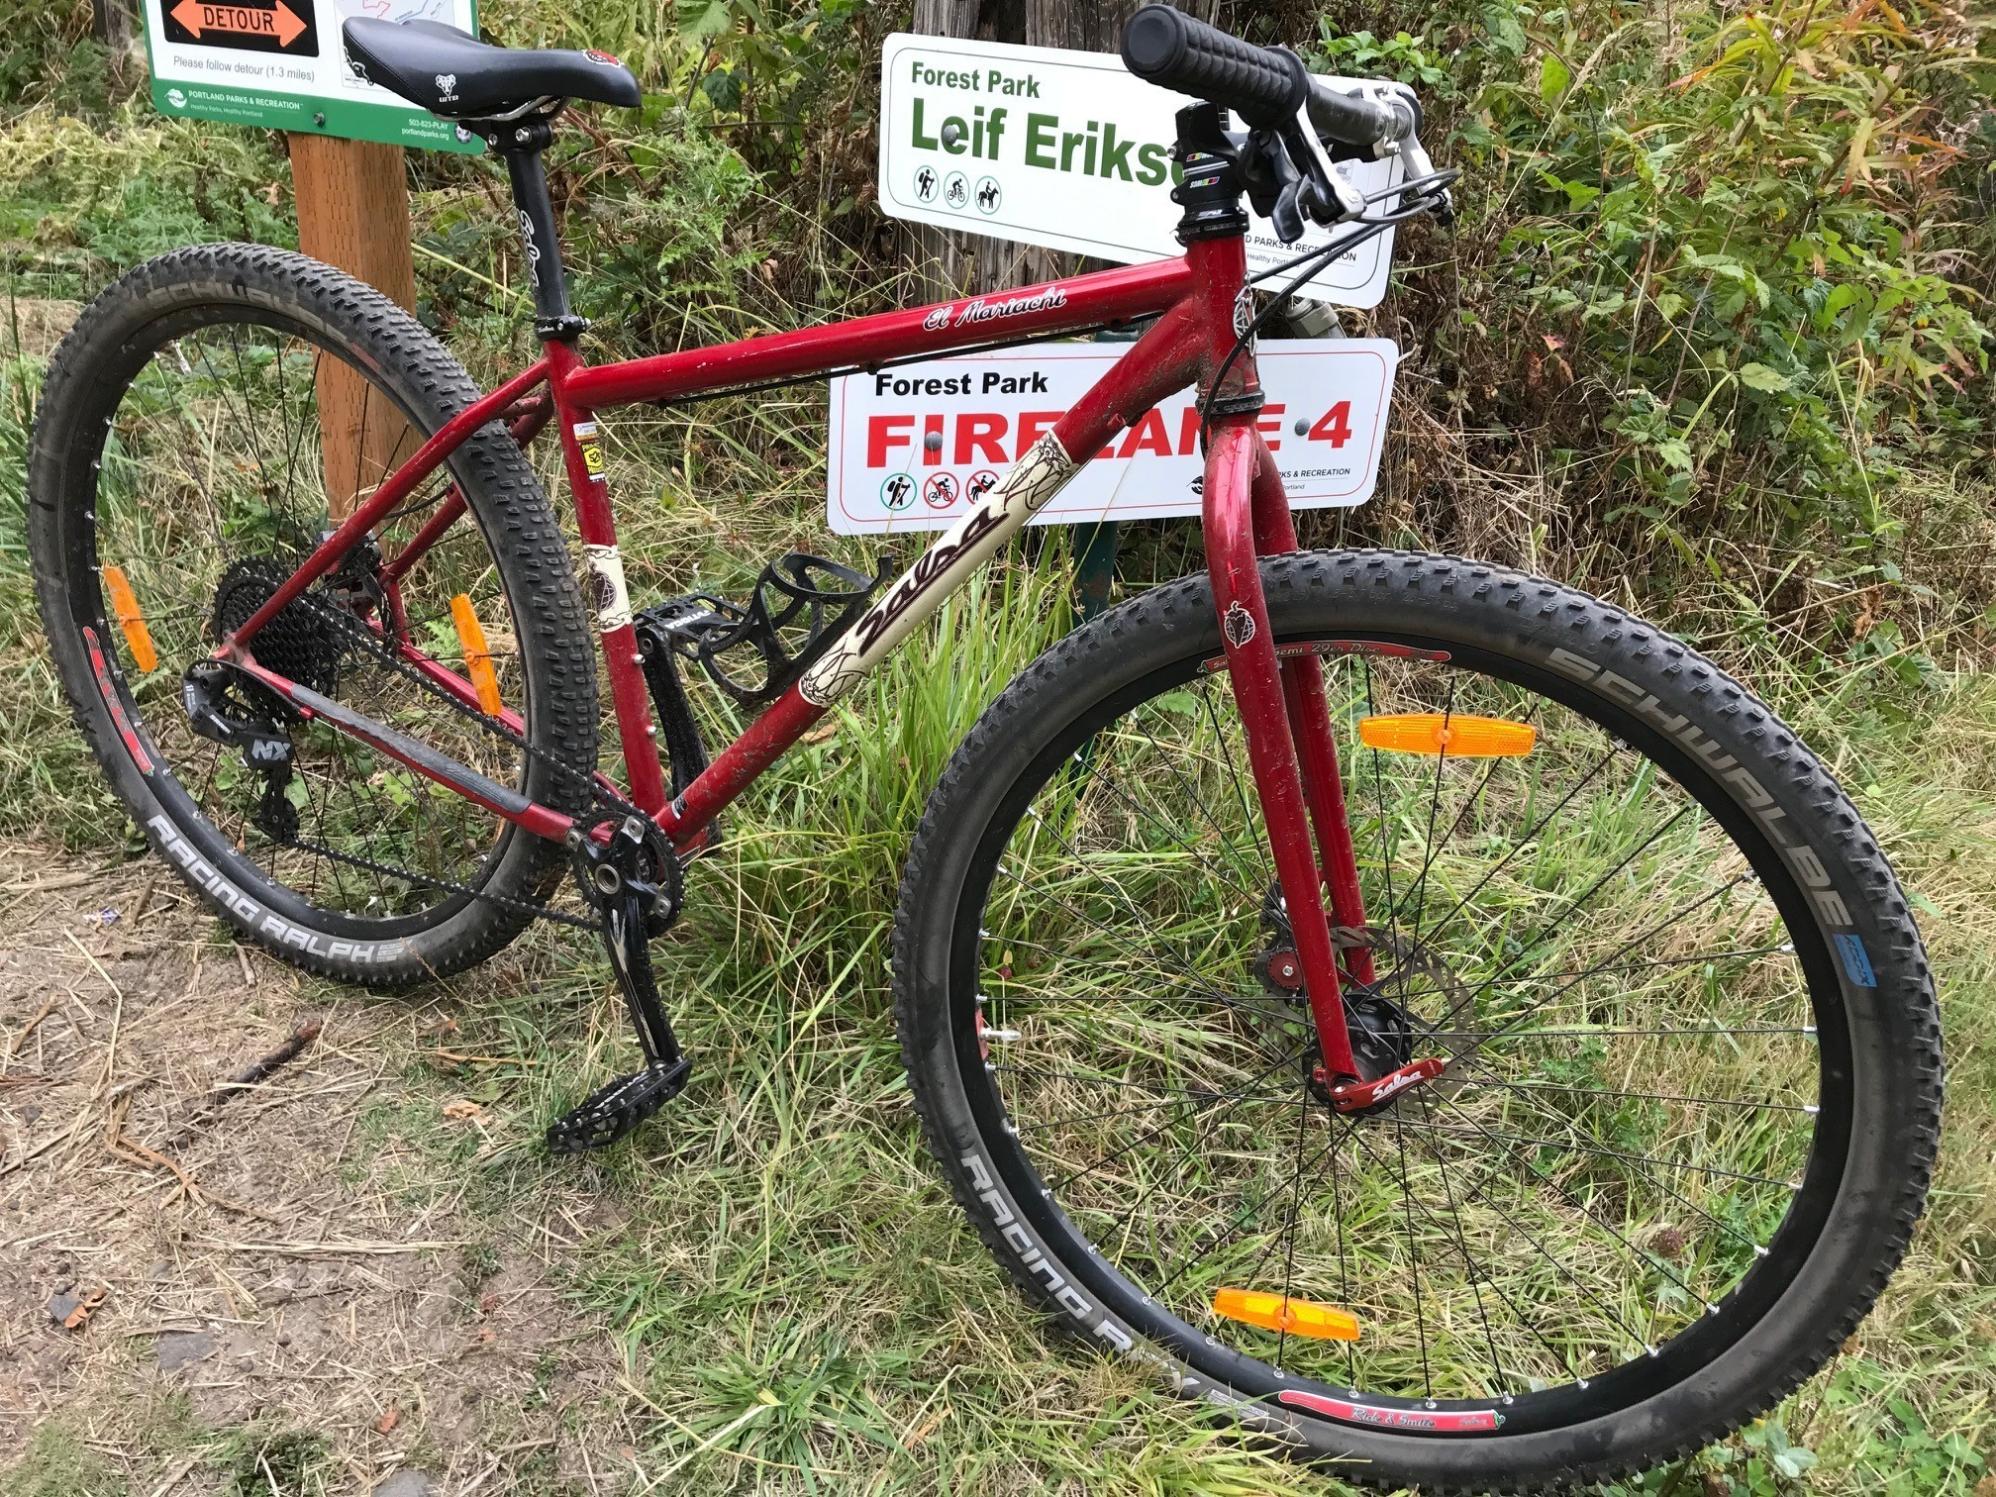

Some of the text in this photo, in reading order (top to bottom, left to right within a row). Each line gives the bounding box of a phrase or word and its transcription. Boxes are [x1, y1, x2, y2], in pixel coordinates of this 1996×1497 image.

[203, 6, 275, 32] DETOUR
[173, 55, 315, 83] Please follow detour (1.3 miles)
[911, 62, 1040, 99] Forest Park
[188, 90, 300, 110] PORTLAND PARKS & RECREATION
[401, 128, 449, 140] portlandparks.org
[911, 97, 1007, 160] Leif
[1254, 236, 1284, 250] PARKS
[1286, 242, 1293, 251] &
[923, 286, 1067, 331] El Mariachi
[875, 371, 1048, 397] Forest Park
[867, 401, 1352, 468] FIREAE 4
[1301, 467, 1351, 478] RECREATION
[251, 739, 291, 760] NX
[1544, 647, 1854, 926] SCHWALBE
[147, 814, 374, 963] RACING RALPH
[1372, 1070, 1425, 1102] Salsa
[960, 1153, 1093, 1319] RACING
